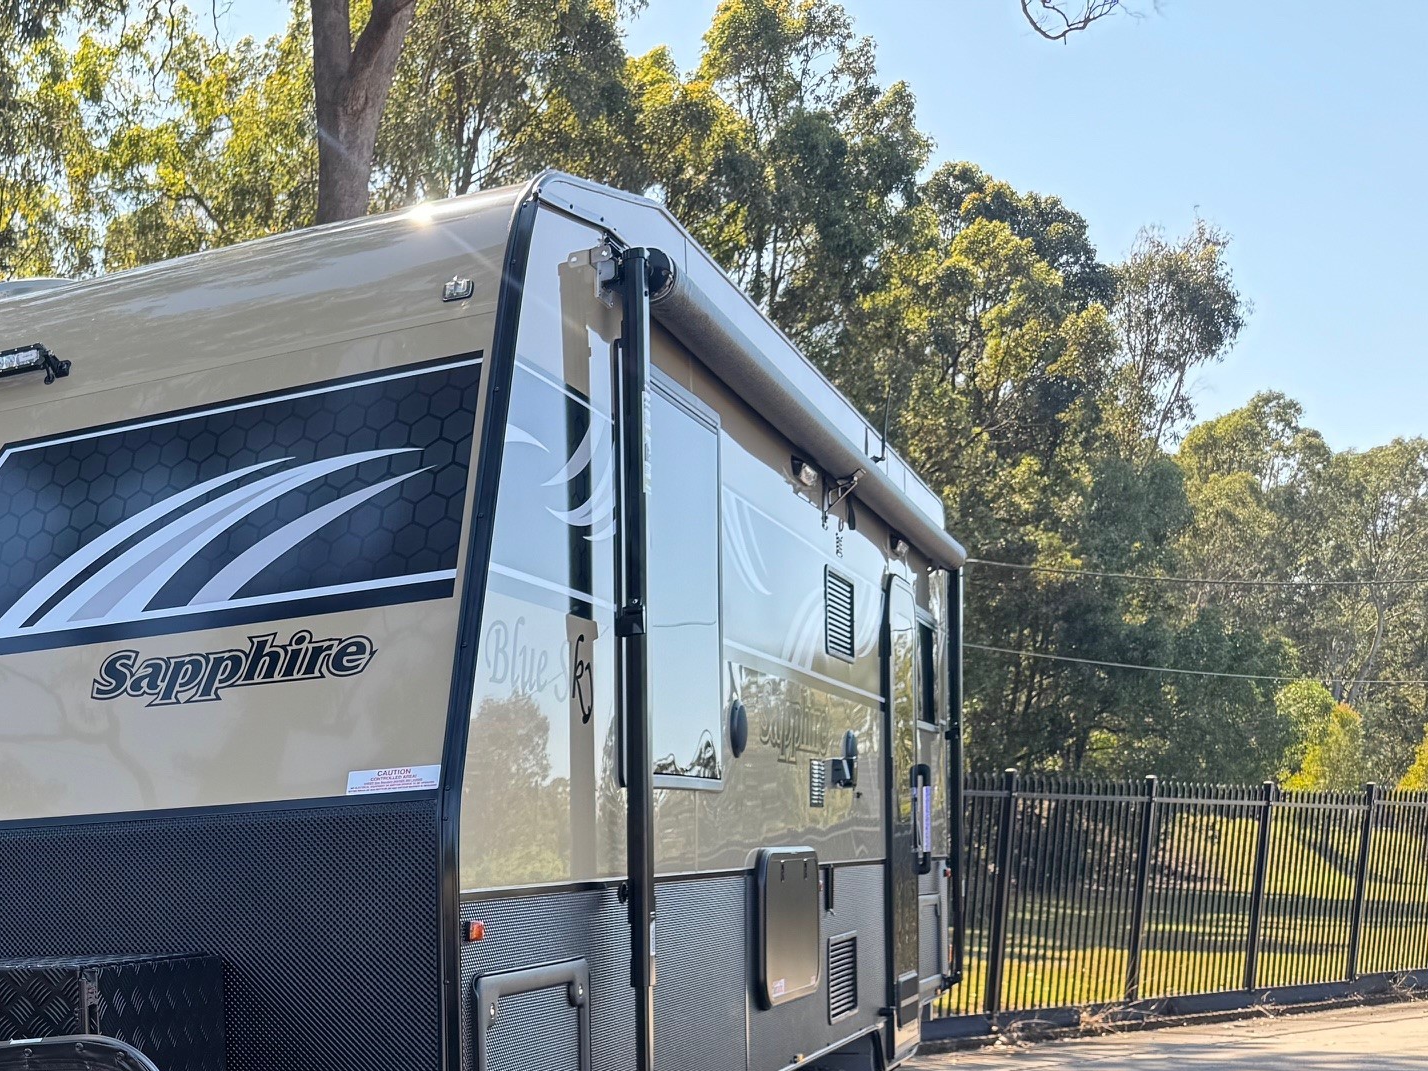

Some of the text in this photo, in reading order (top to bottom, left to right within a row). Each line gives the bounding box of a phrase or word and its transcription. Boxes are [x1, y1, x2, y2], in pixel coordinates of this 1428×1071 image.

[90, 629, 378, 708] Sapphire
[484, 615, 550, 693] Blue
[377, 768, 412, 777] CAUTION
